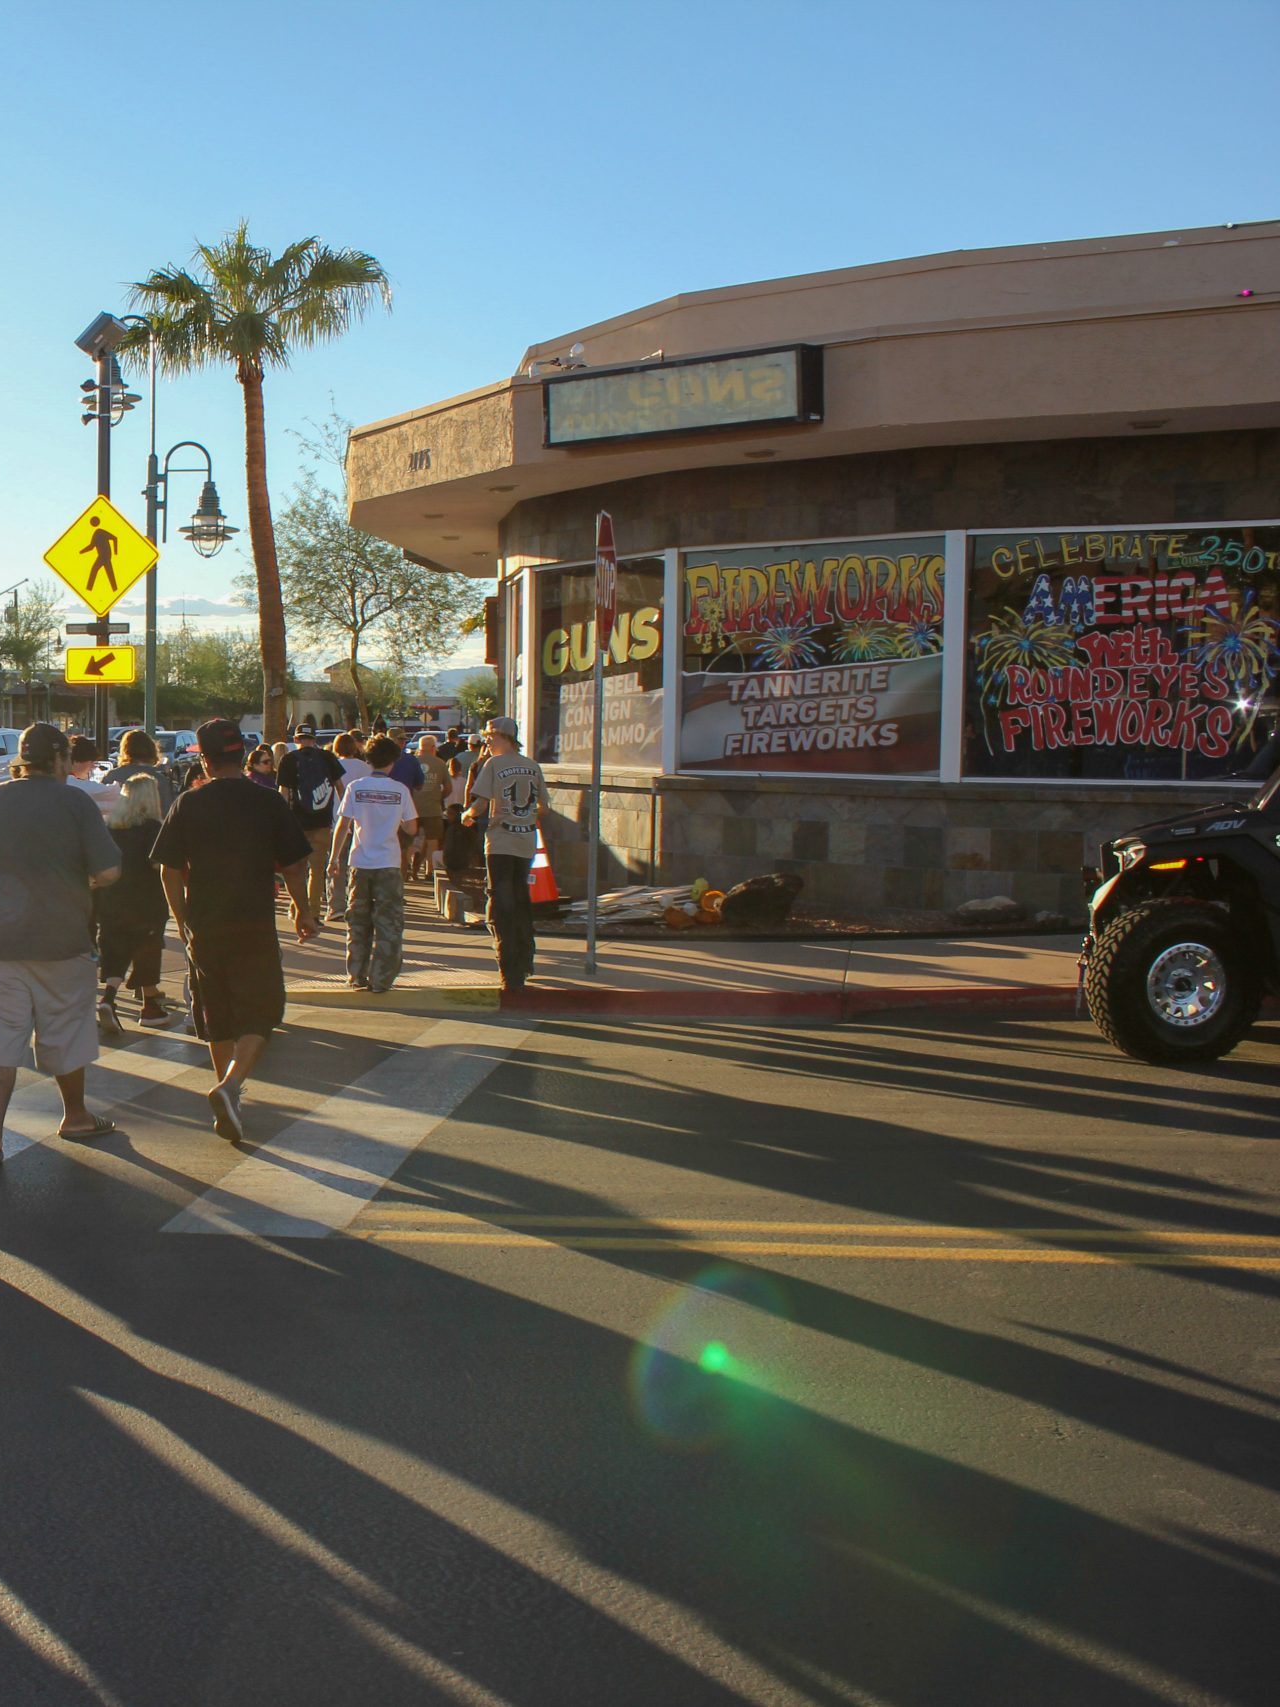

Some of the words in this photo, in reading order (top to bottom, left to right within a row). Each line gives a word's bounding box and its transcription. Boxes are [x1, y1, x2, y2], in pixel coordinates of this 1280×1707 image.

[991, 534, 1189, 578] CELEBRATE
[596, 554, 615, 610] STOP
[683, 553, 946, 637] FIREWORKS
[1022, 569, 1230, 627] AMERICA
[542, 606, 661, 677] GUNS
[560, 681, 590, 704] BUY
[603, 672, 643, 696] SELL
[728, 666, 890, 704] TANNERITE
[565, 699, 631, 728] CONIGN
[743, 696, 876, 730] TARGETS
[999, 698, 1233, 758] FIREWORKS
[554, 729, 594, 753] BULK
[724, 723, 899, 757] FIREWORKS
[312, 777, 330, 803] NIKE
[1205, 819, 1247, 832] ADV
